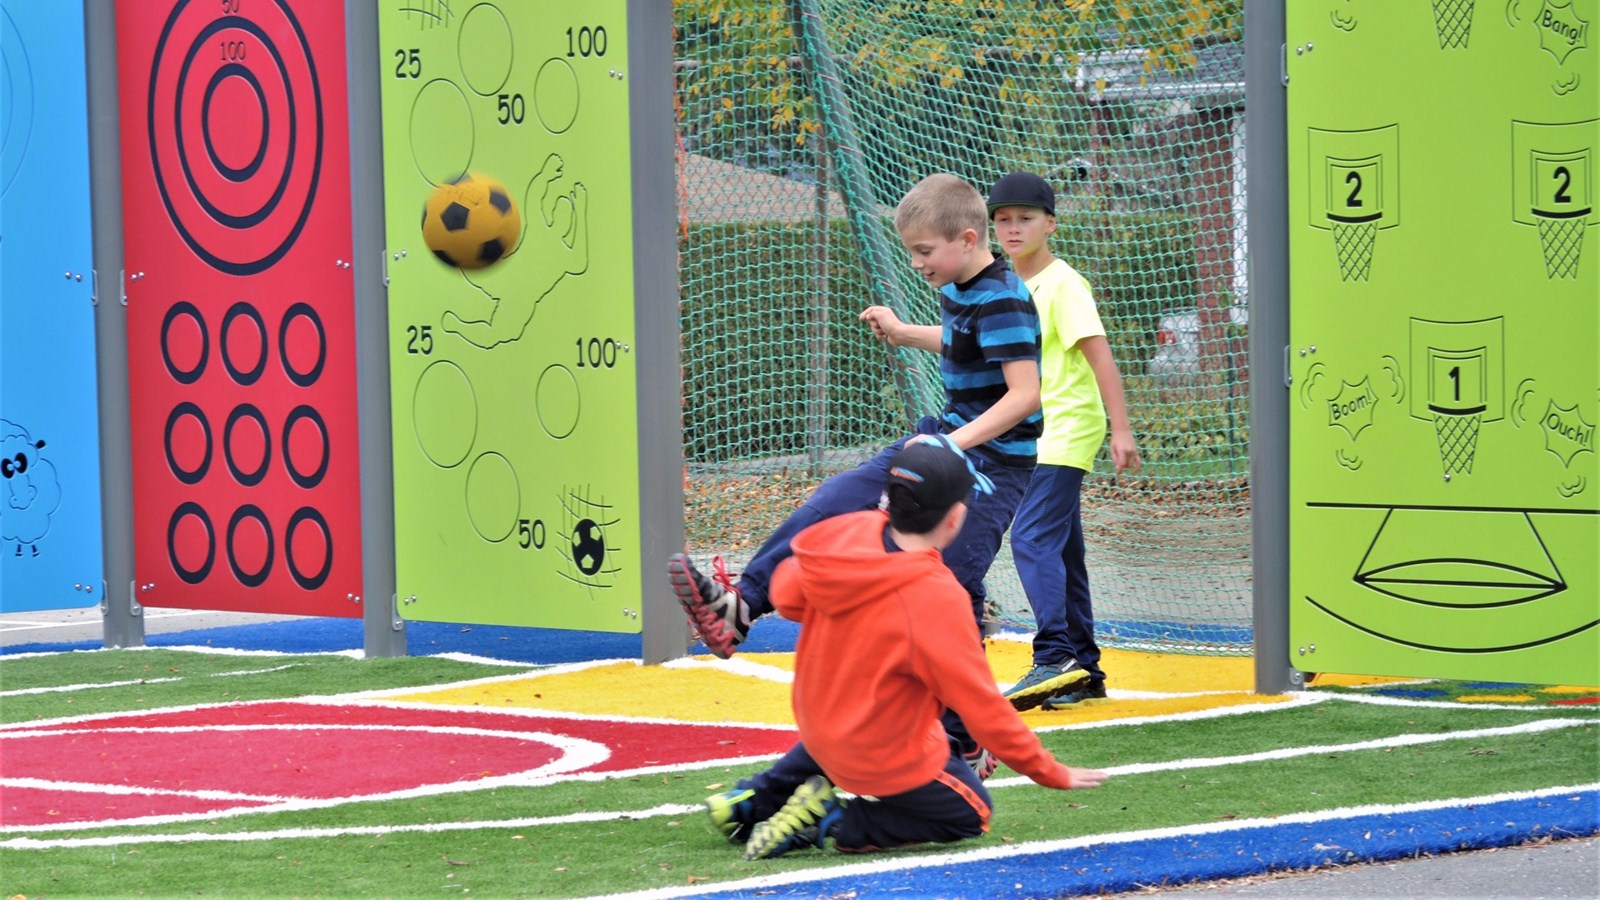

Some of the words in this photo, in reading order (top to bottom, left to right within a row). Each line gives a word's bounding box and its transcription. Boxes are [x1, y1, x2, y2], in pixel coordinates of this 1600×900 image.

[566, 25, 608, 57] 100
[1541, 8, 1583, 45] Bang!
[220, 41, 246, 61] 100
[395, 48, 421, 79] 25
[498, 93, 525, 125] 50
[1345, 171, 1363, 207] 2
[1552, 166, 1571, 203] 2
[406, 325, 433, 355] 25
[576, 337, 616, 368] 100
[1448, 366, 1460, 401] 1
[1331, 387, 1372, 420] Boom!
[1547, 413, 1590, 447] Ouch!
[518, 519, 546, 550] 50
